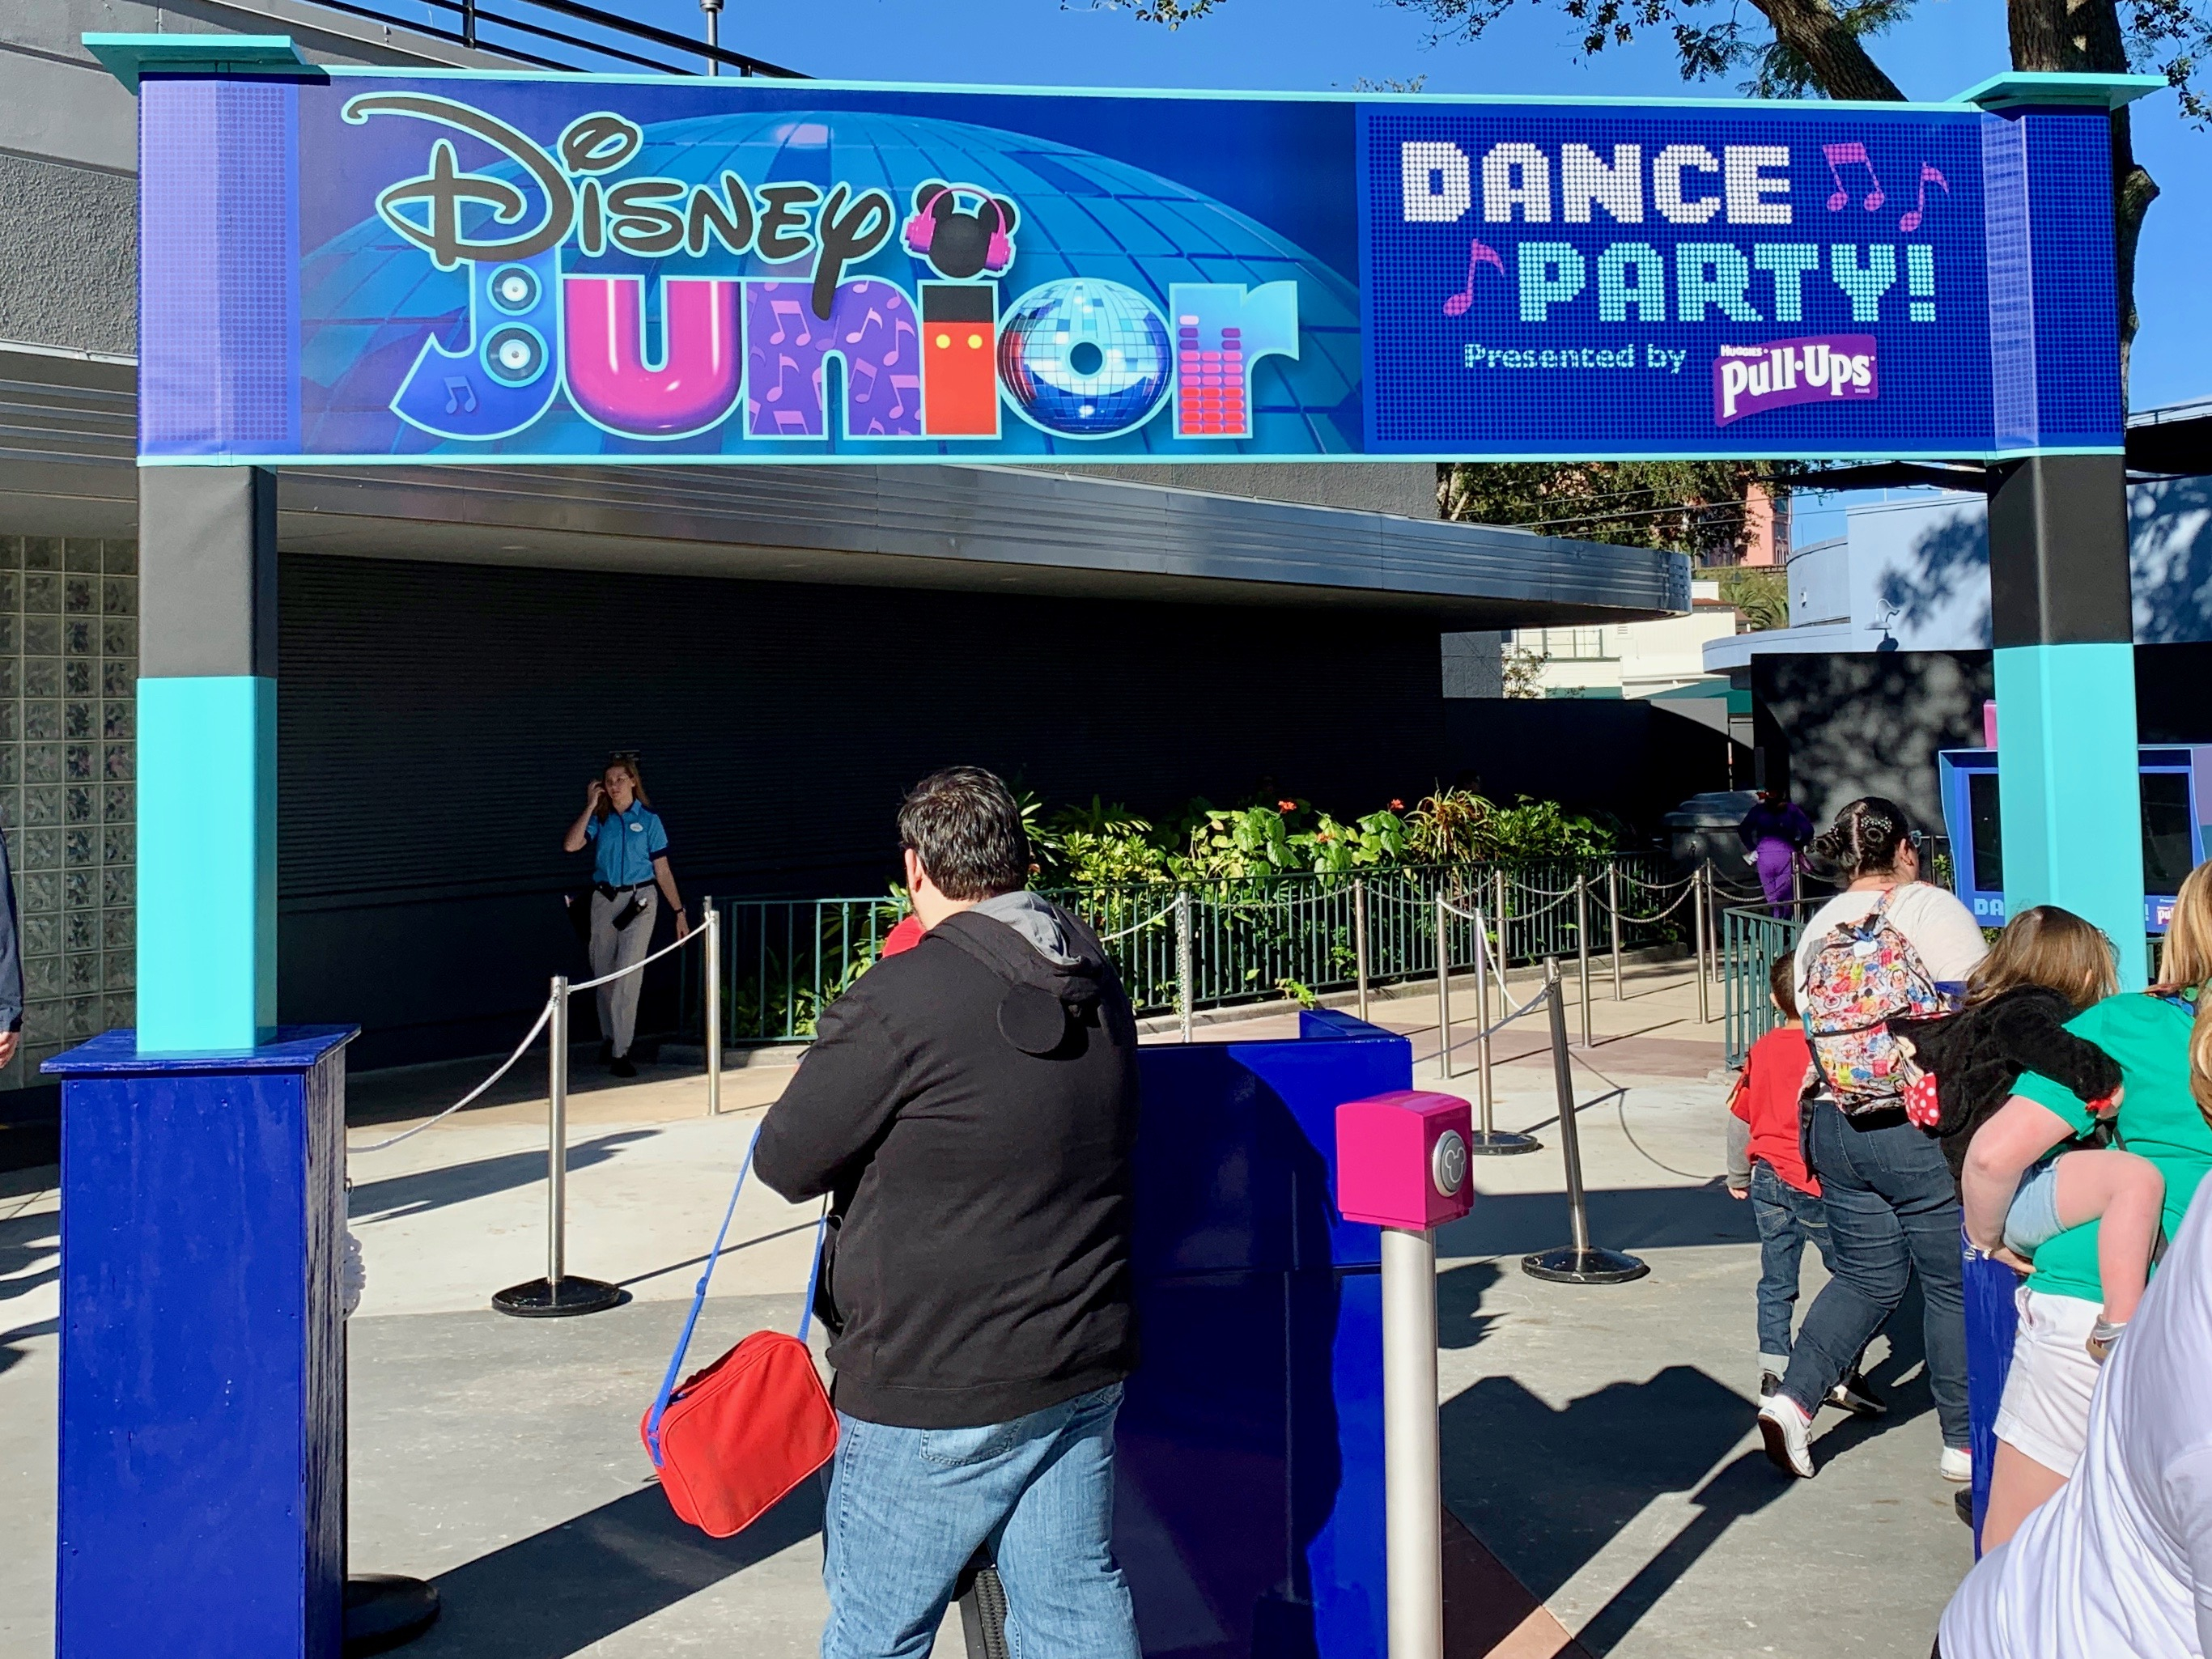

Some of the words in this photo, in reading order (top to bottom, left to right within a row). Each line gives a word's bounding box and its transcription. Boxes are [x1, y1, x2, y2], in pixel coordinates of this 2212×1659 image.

[1402, 141, 1793, 224] DANCE
[389, 178, 1299, 442] Junior
[1518, 242, 1936, 322] PARTY!
[1465, 343, 1634, 367] Presented
[1648, 343, 1687, 374] by
